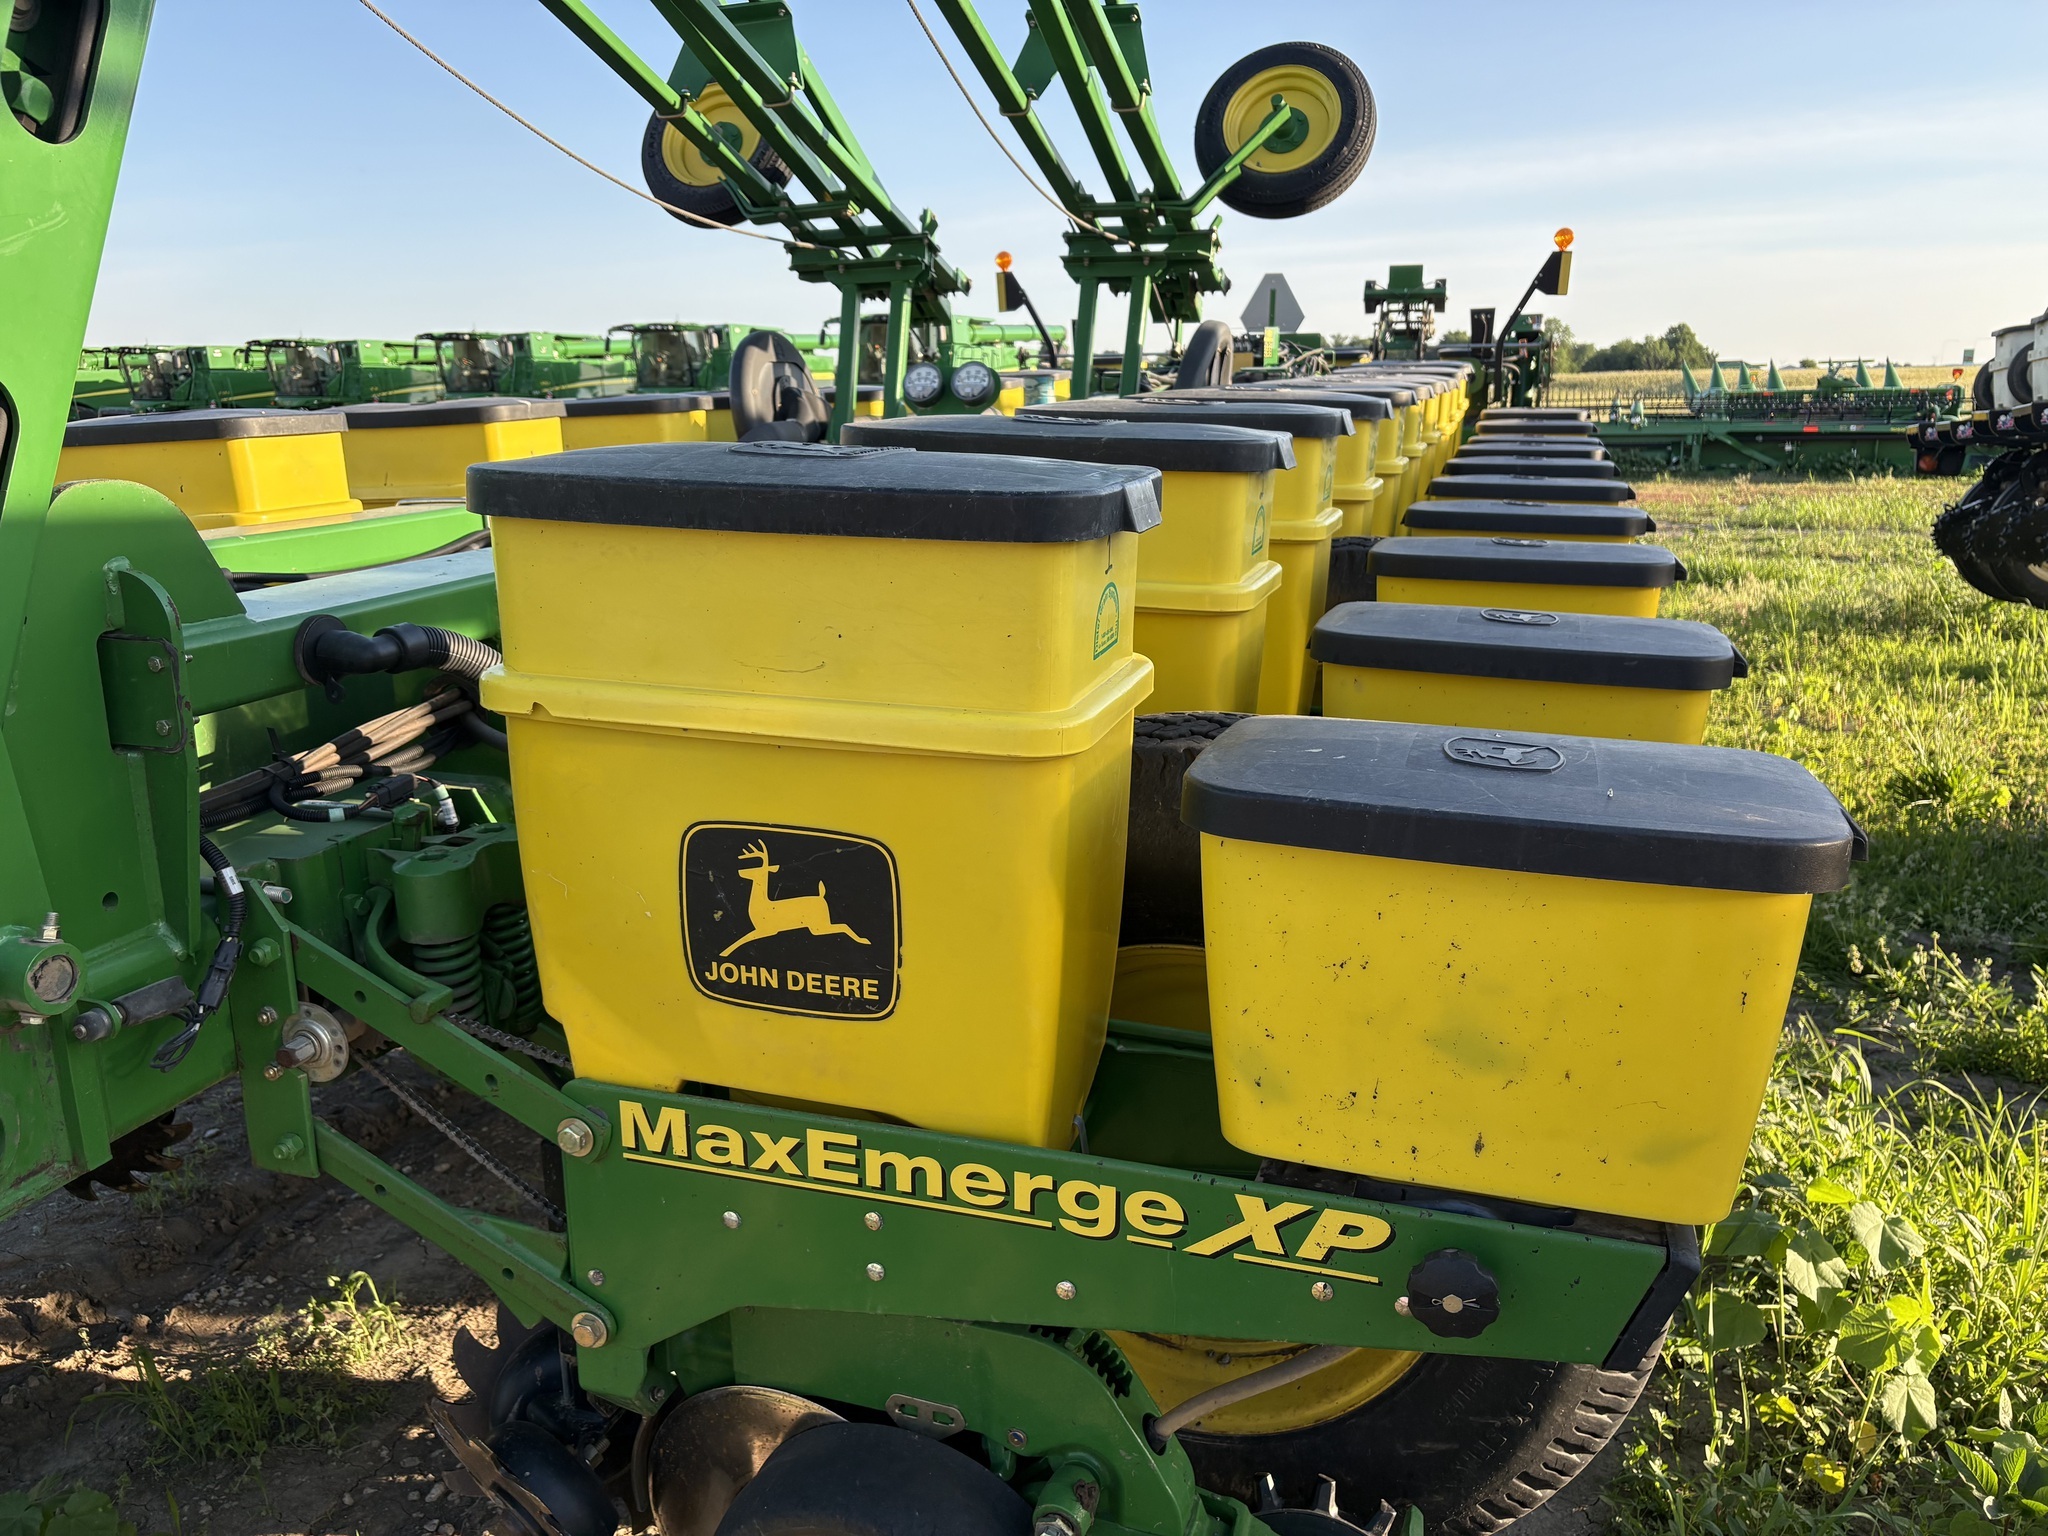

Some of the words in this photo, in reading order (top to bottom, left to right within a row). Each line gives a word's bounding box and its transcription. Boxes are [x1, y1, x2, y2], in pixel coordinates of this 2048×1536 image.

[704, 961, 779, 989] JOHN
[786, 970, 880, 1001] DEERE
[618, 1099, 1187, 1240] MaxEmerge
[1181, 1192, 1395, 1263] XP
